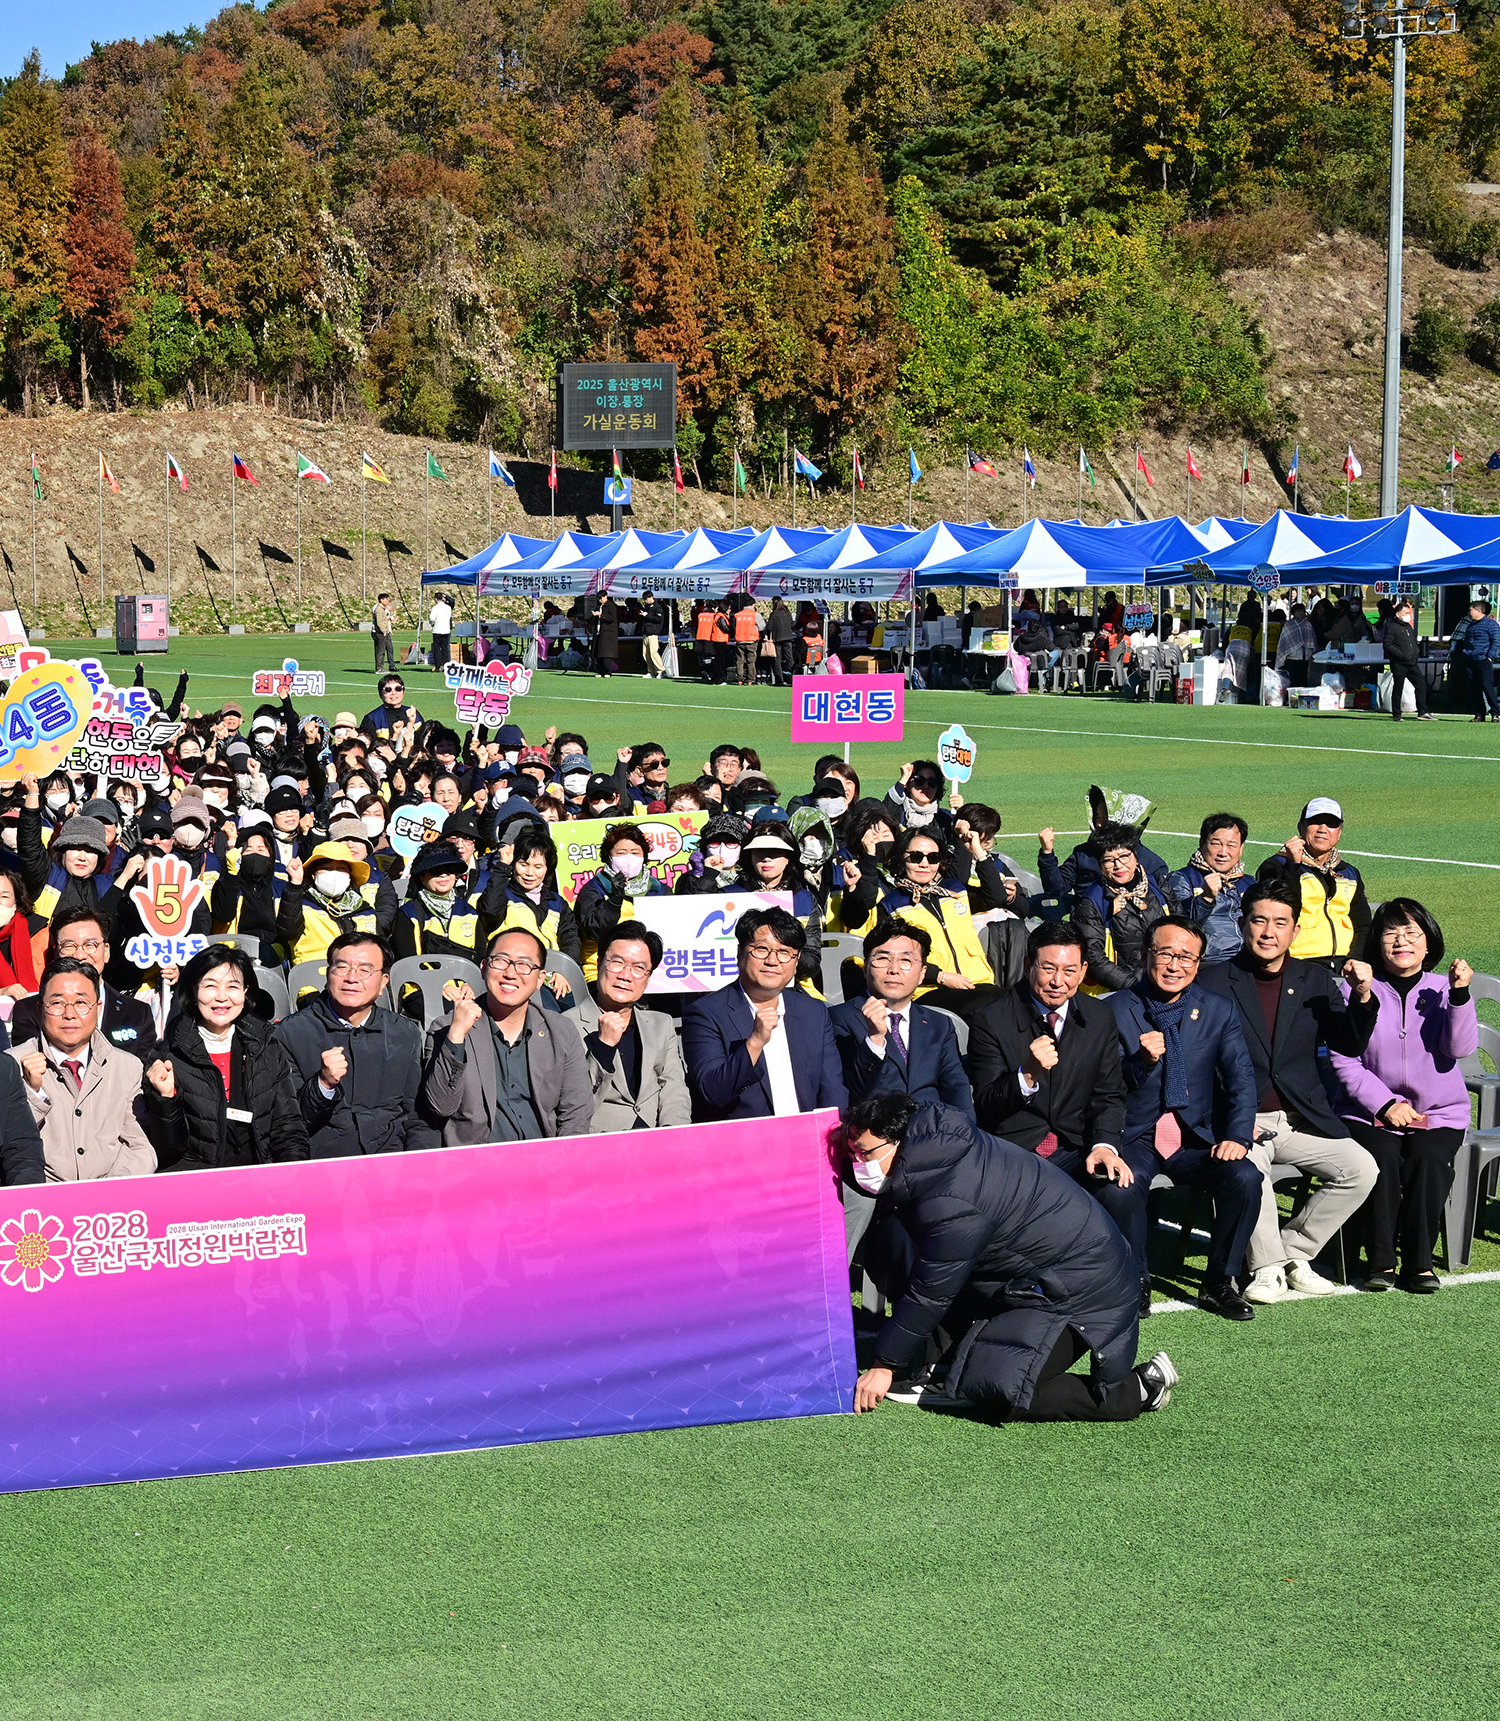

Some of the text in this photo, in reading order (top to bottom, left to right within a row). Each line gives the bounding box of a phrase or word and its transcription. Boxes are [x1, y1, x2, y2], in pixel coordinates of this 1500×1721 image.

[577, 378, 663, 391] 2025 울산광역시
[596, 395, 644, 408] 이장.통장
[583, 413, 657, 431] 가실운동회
[560, 576, 572, 590] 동구
[697, 577, 711, 592] 동구
[824, 577, 832, 593] 더
[833, 577, 856, 594] 잘사는
[858, 577, 874, 594] 동구
[447, 664, 510, 691] 함께하는
[93, 692, 151, 720] 거동
[457, 688, 509, 727] 달동
[803, 691, 895, 722] 대현동
[82, 717, 152, 751] 현동은
[395, 816, 442, 843] 탄탄대
[155, 884, 182, 925] 5
[663, 948, 739, 979] 행복남
[75, 1213, 145, 1242] 2028
[168, 1215, 304, 1235] 2028 Ulsan International Garden Expo
[74, 1226, 305, 1272] 울산국제정원박람회
